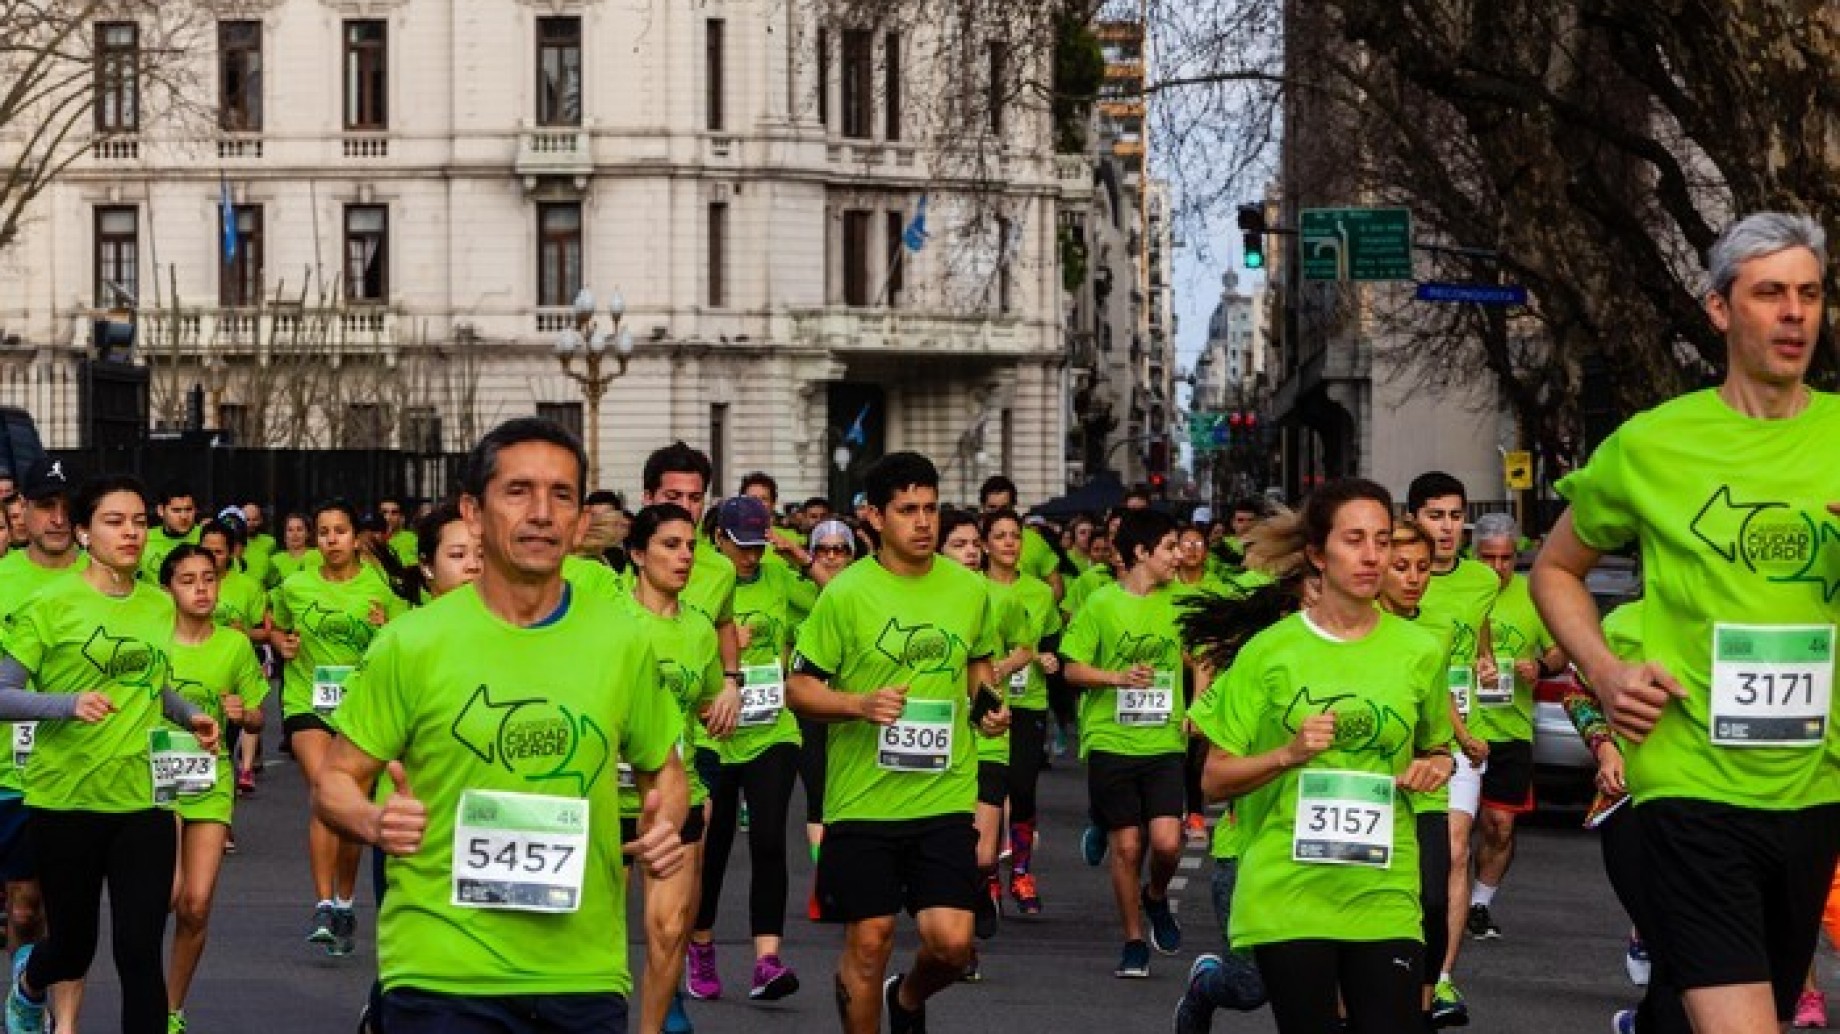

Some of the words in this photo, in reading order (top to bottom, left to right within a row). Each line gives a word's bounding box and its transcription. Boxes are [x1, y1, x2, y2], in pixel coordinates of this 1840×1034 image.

[1747, 533, 1808, 546] CIUDAD
[1747, 546, 1807, 560] VERDE
[1734, 673, 1812, 705] 3171
[1124, 691, 1165, 709] 5712
[505, 728, 568, 746] CIUDAD
[885, 725, 950, 749] 6306
[504, 741, 566, 760] VERDE
[1308, 804, 1381, 835] 3157
[467, 838, 576, 874] 5457
